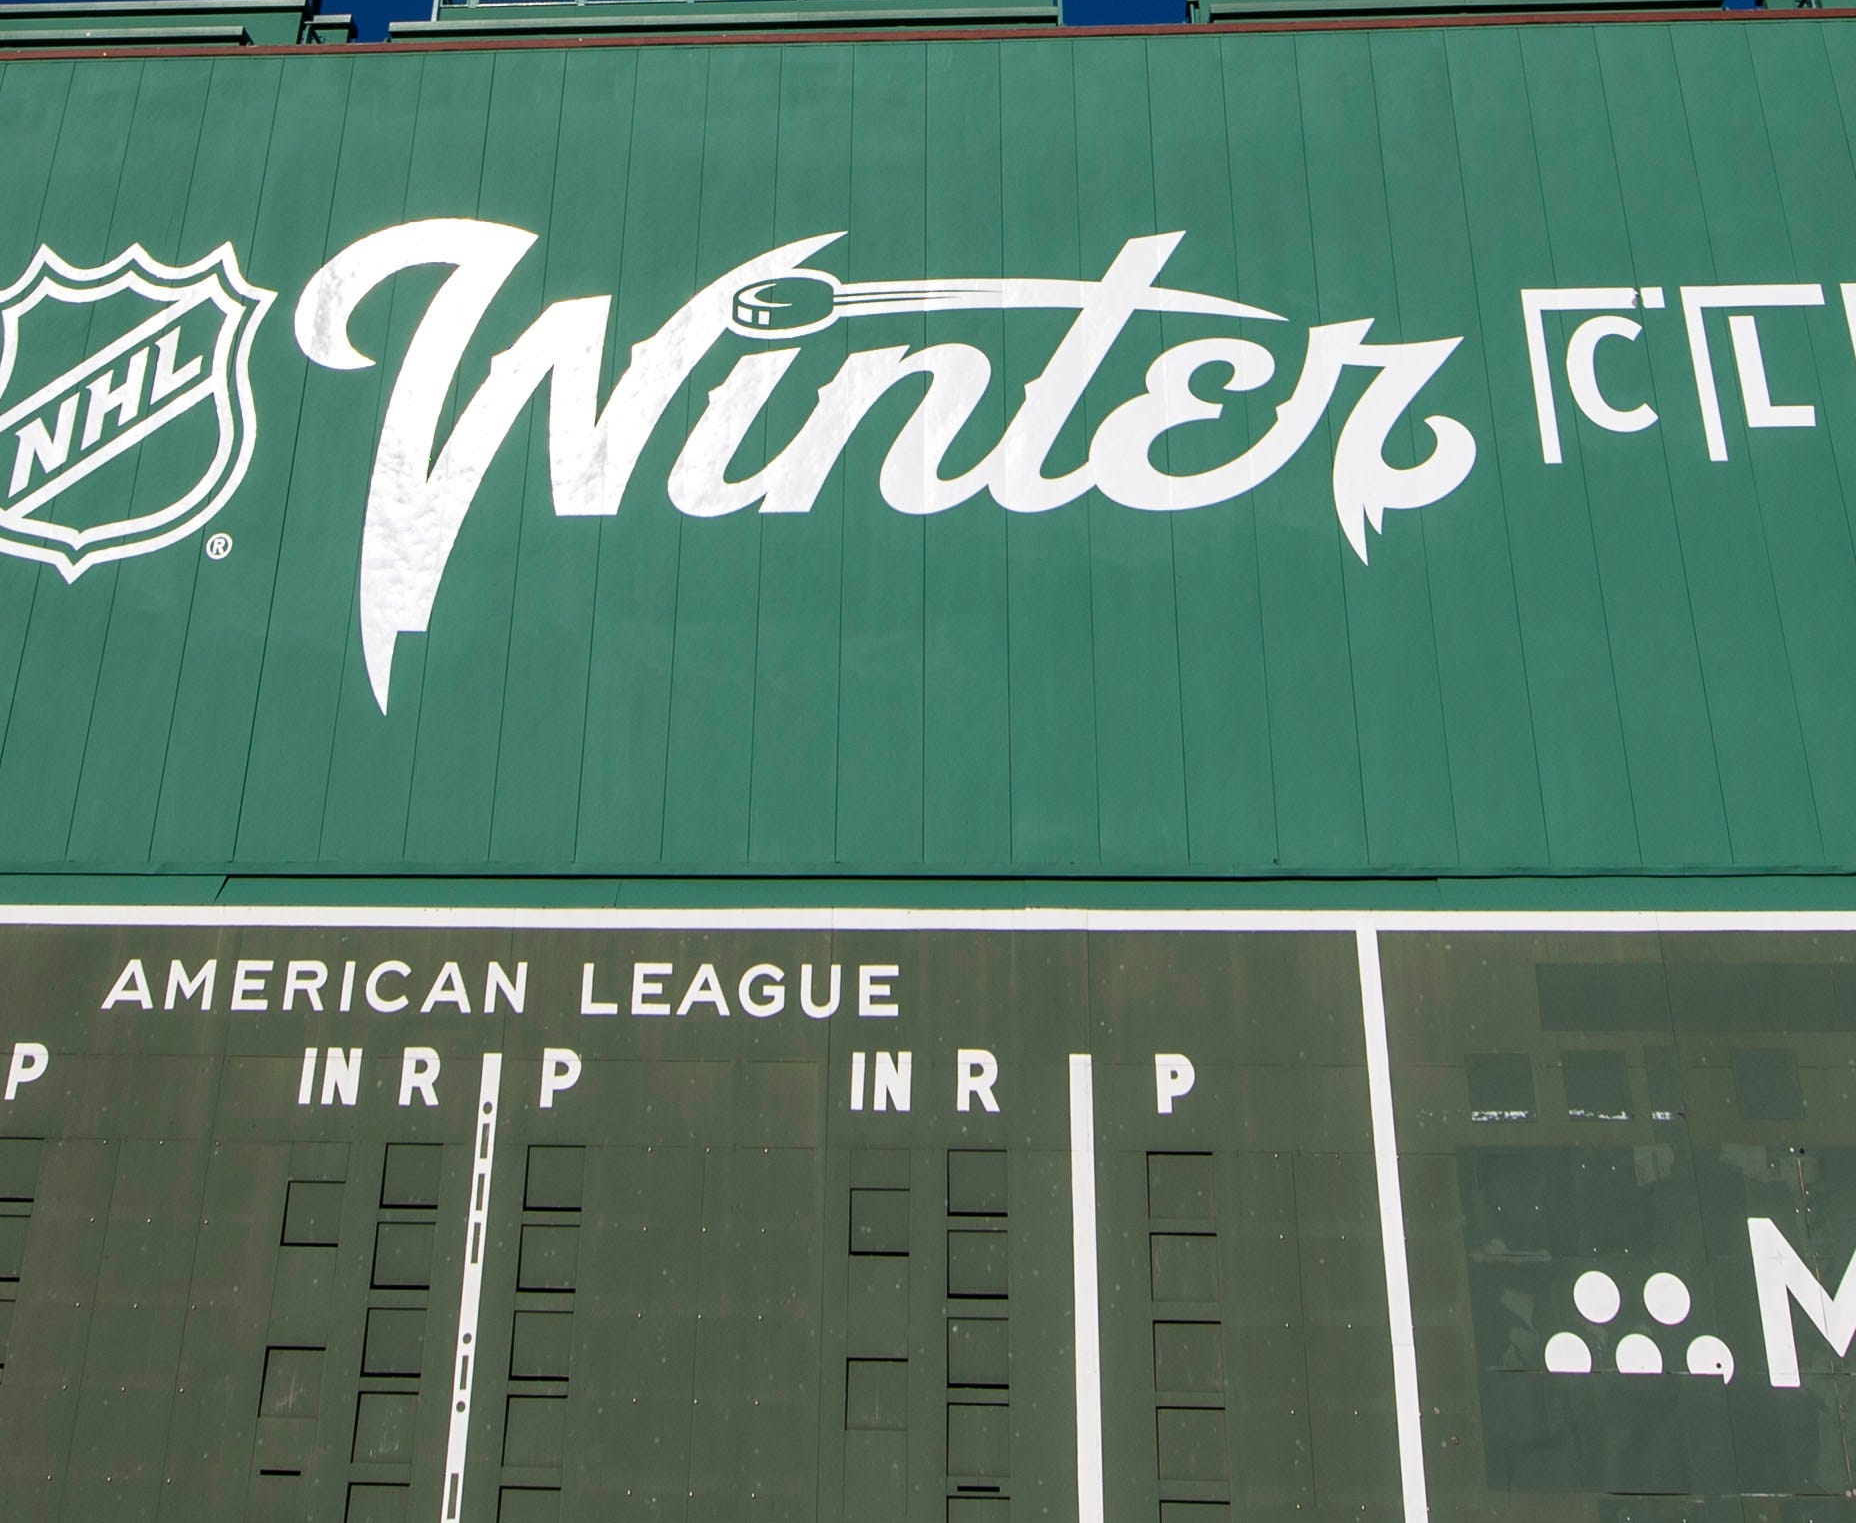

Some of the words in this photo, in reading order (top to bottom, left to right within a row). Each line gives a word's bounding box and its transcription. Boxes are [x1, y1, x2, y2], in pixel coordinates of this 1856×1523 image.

[7, 325, 204, 499] NHL
[294, 218, 1476, 715] Winter
[101, 960, 527, 1013] AMERICAN
[581, 963, 899, 1018] LEAGUE
[5, 1043, 48, 1100] P
[298, 1048, 362, 1105] IN
[399, 1047, 440, 1105] R
[540, 1048, 581, 1108] P
[851, 1052, 912, 1111] IN
[957, 1049, 1000, 1112] R
[1155, 1054, 1195, 1113] P
